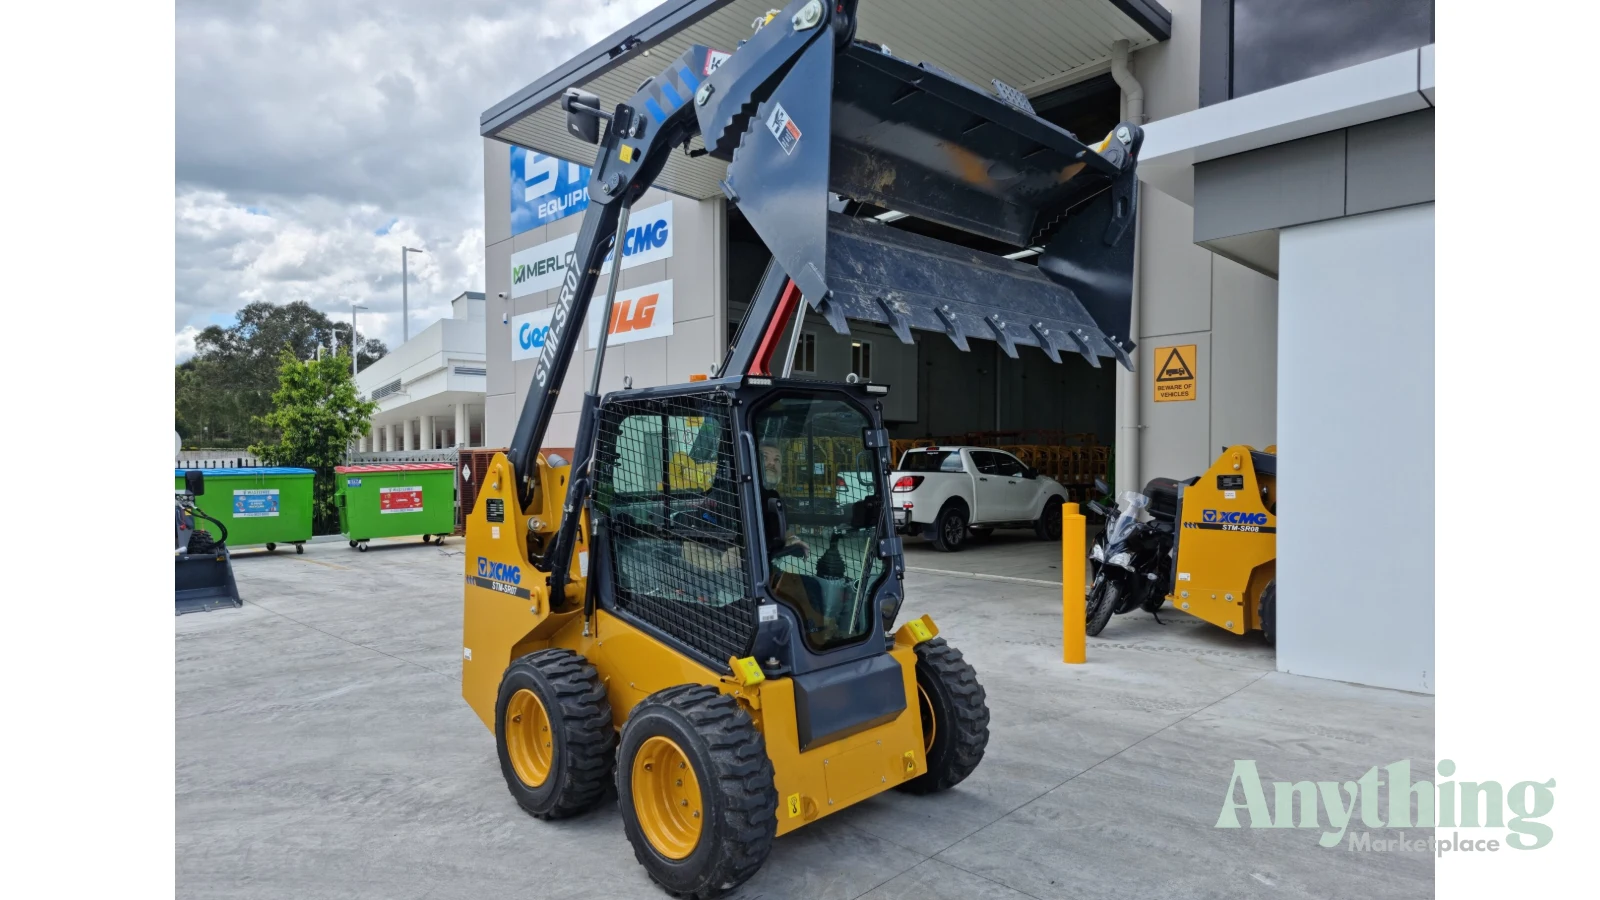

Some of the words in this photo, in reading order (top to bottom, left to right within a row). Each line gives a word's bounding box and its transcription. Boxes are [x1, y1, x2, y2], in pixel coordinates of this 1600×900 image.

[604, 219, 668, 261] CMG
[536, 253, 581, 387] STM-SR07
[1218, 511, 1267, 525] XCMG
[1222, 524, 1260, 533] STM-SR08
[488, 561, 521, 585] XCMG
[491, 581, 518, 596] STM-SR07
